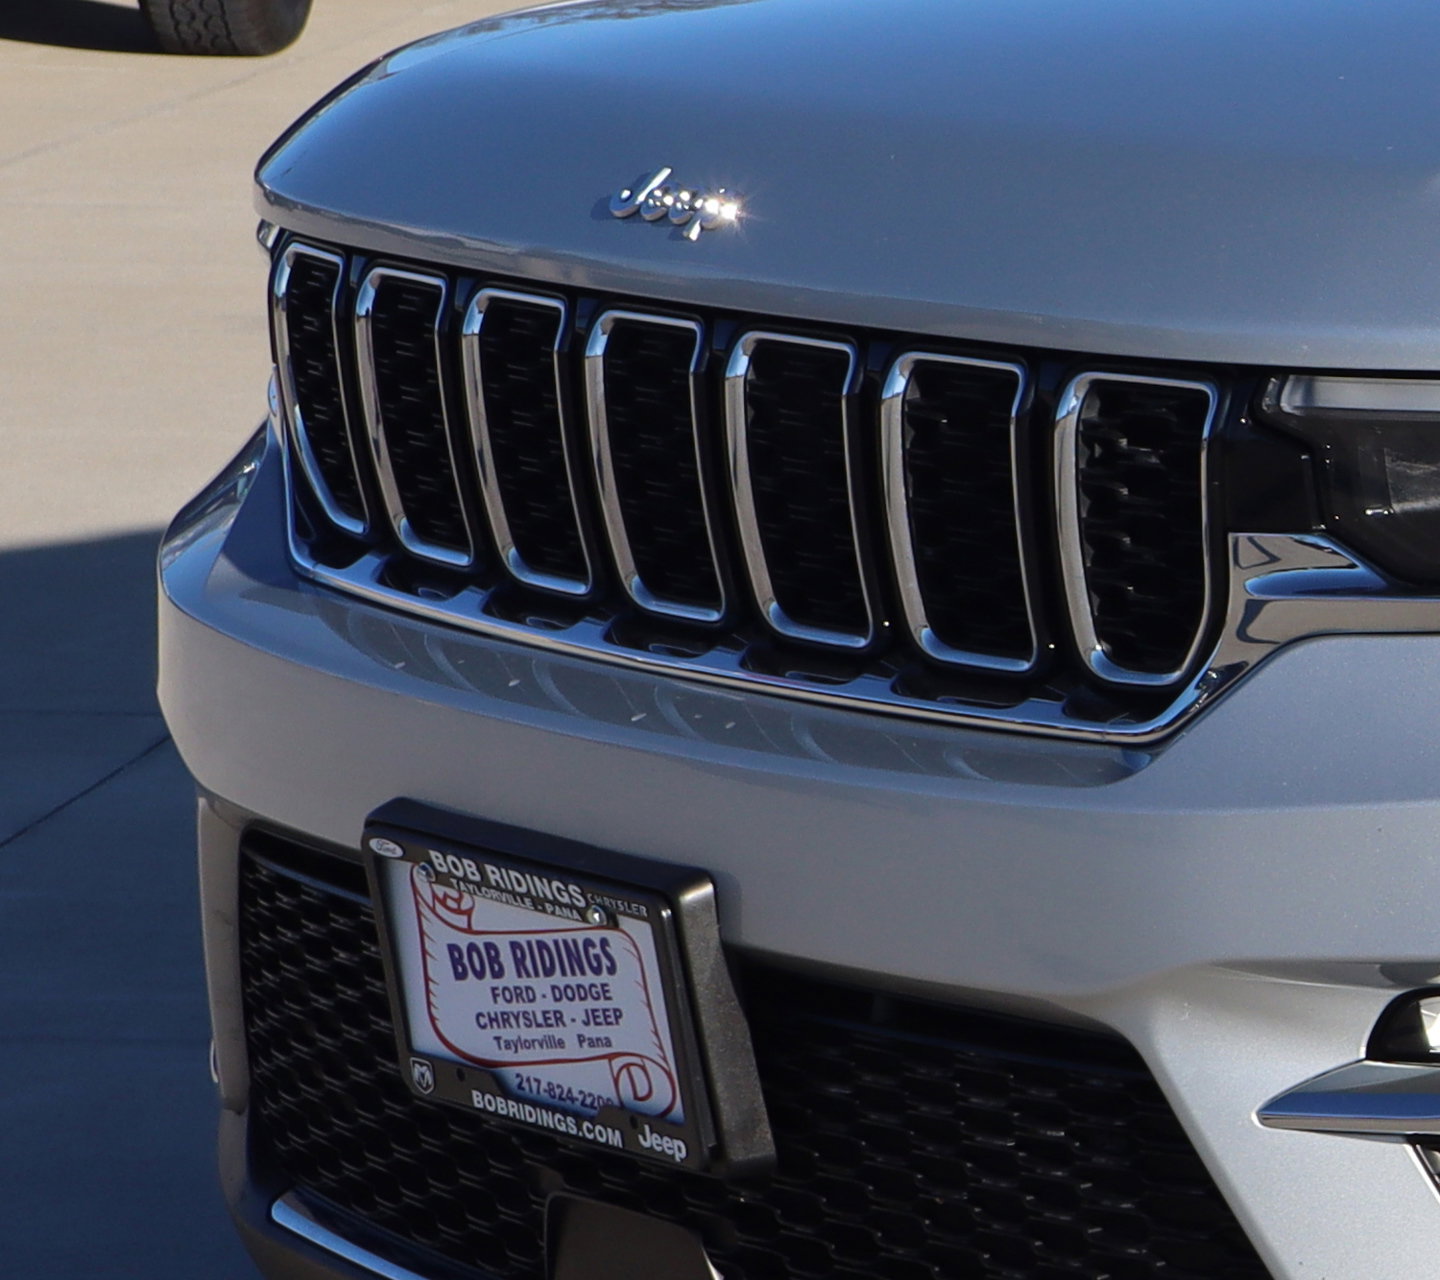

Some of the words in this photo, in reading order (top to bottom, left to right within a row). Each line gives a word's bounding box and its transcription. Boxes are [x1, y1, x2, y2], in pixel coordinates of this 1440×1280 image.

[609, 166, 740, 242] Jeep
[428, 849, 481, 882] BOB
[485, 863, 586, 908] RIDINGS
[450, 878, 535, 910] TAYLORVILLE
[544, 903, 583, 921] PANA
[587, 893, 648, 918] CHRYSLER
[447, 942, 505, 981] BOB
[509, 937, 617, 979] RIDINGS
[490, 985, 537, 1004] FORD
[551, 982, 613, 1002] DODGE
[475, 1010, 567, 1030] CHRYSLER
[582, 1007, 623, 1027] JEEP
[493, 1035, 566, 1054] Taylorville
[576, 1033, 613, 1049] Pana
[471, 1089, 623, 1148] BOBRIDINGS.COM
[638, 1124, 687, 1162] Jeep
